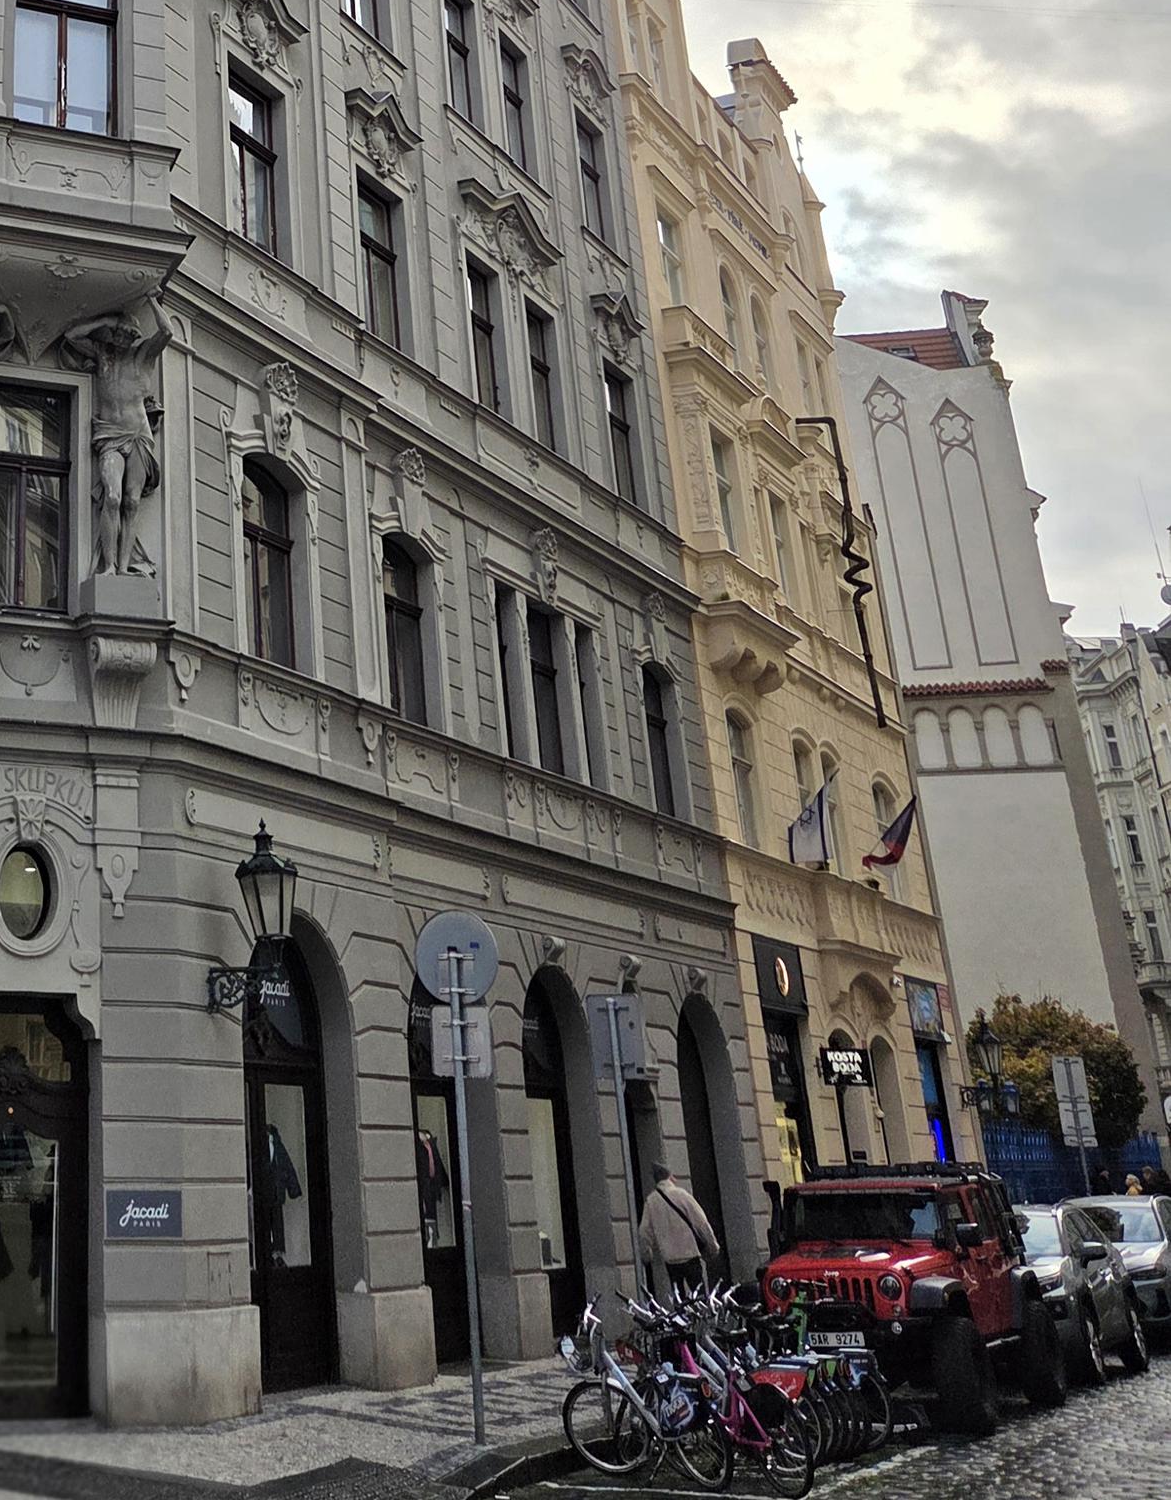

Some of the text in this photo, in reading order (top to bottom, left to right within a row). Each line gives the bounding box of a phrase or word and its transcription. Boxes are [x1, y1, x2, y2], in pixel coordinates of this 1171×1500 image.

[826, 1050, 863, 1063] KOSTA
[831, 1061, 863, 1073] BODA
[119, 1198, 170, 1228] jacadi
[133, 1220, 161, 1228] PARIS
[810, 1333, 860, 1346] 5AR 9274
